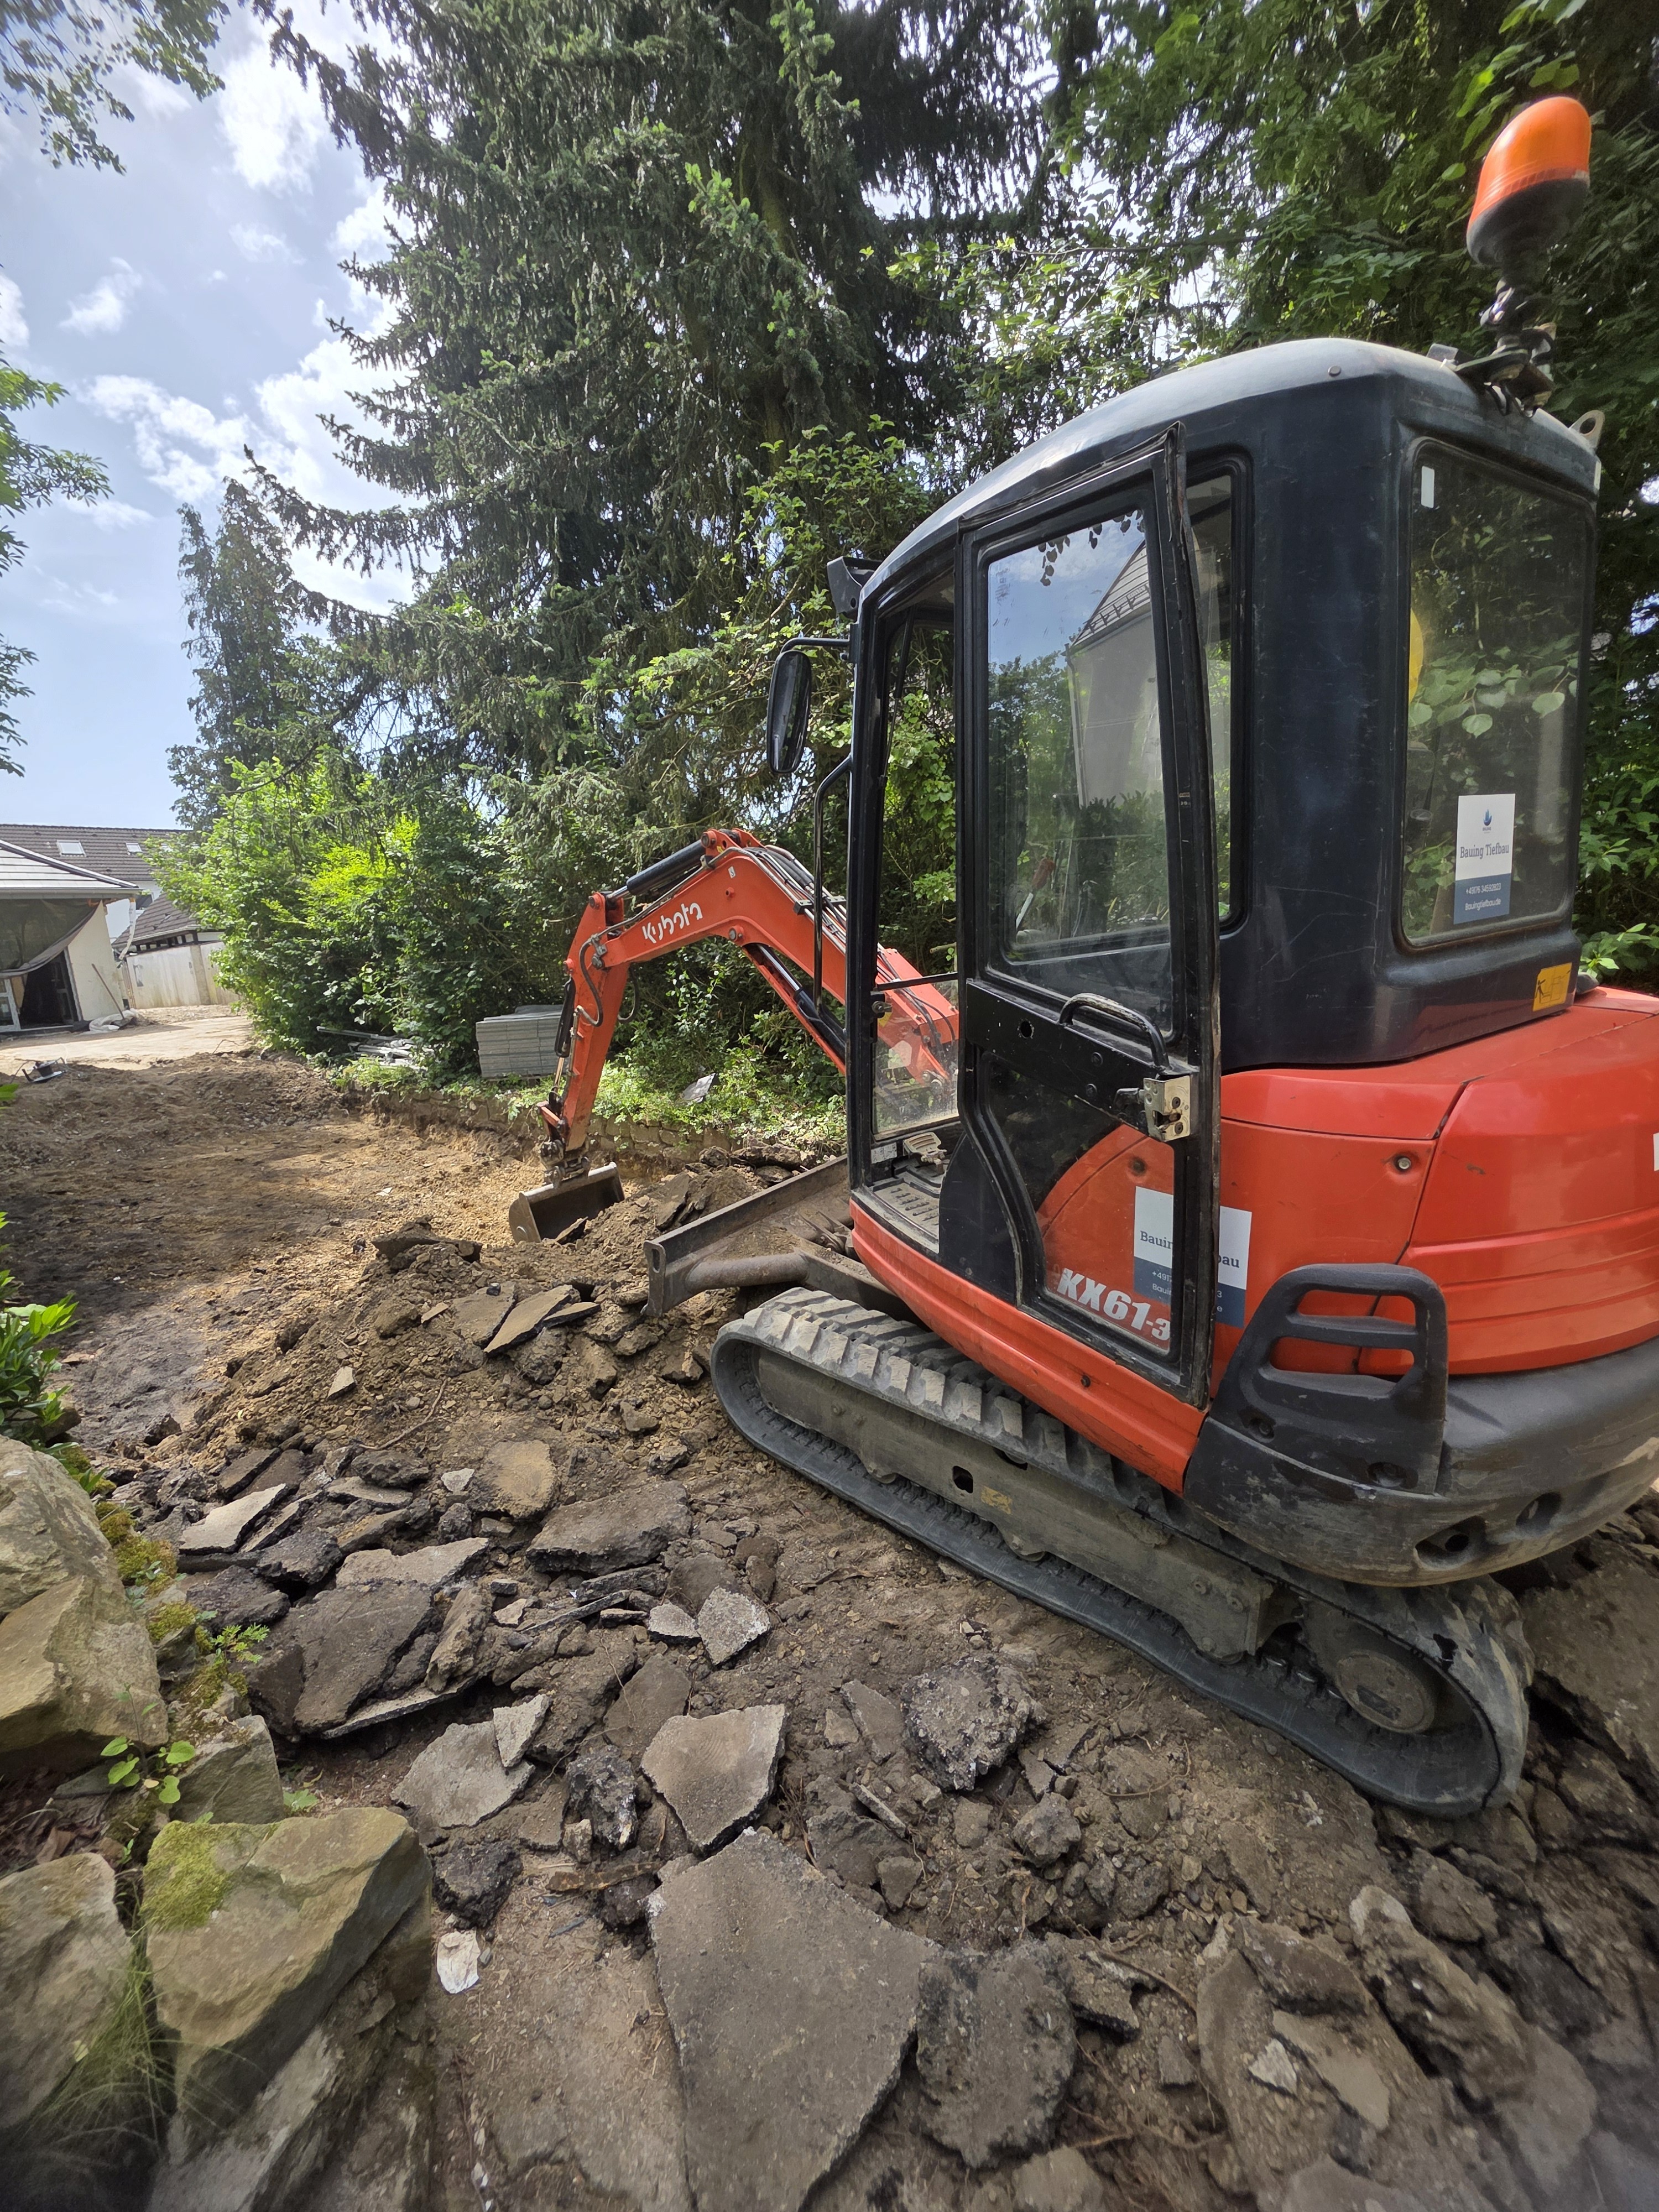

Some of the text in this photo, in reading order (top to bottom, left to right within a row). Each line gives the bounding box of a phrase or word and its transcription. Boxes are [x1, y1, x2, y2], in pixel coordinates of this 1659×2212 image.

[1460, 842, 1509, 859] Bauing Tiefbau
[642, 902, 703, 943] Kubota
[1057, 1267, 1170, 1340] KX61-3
